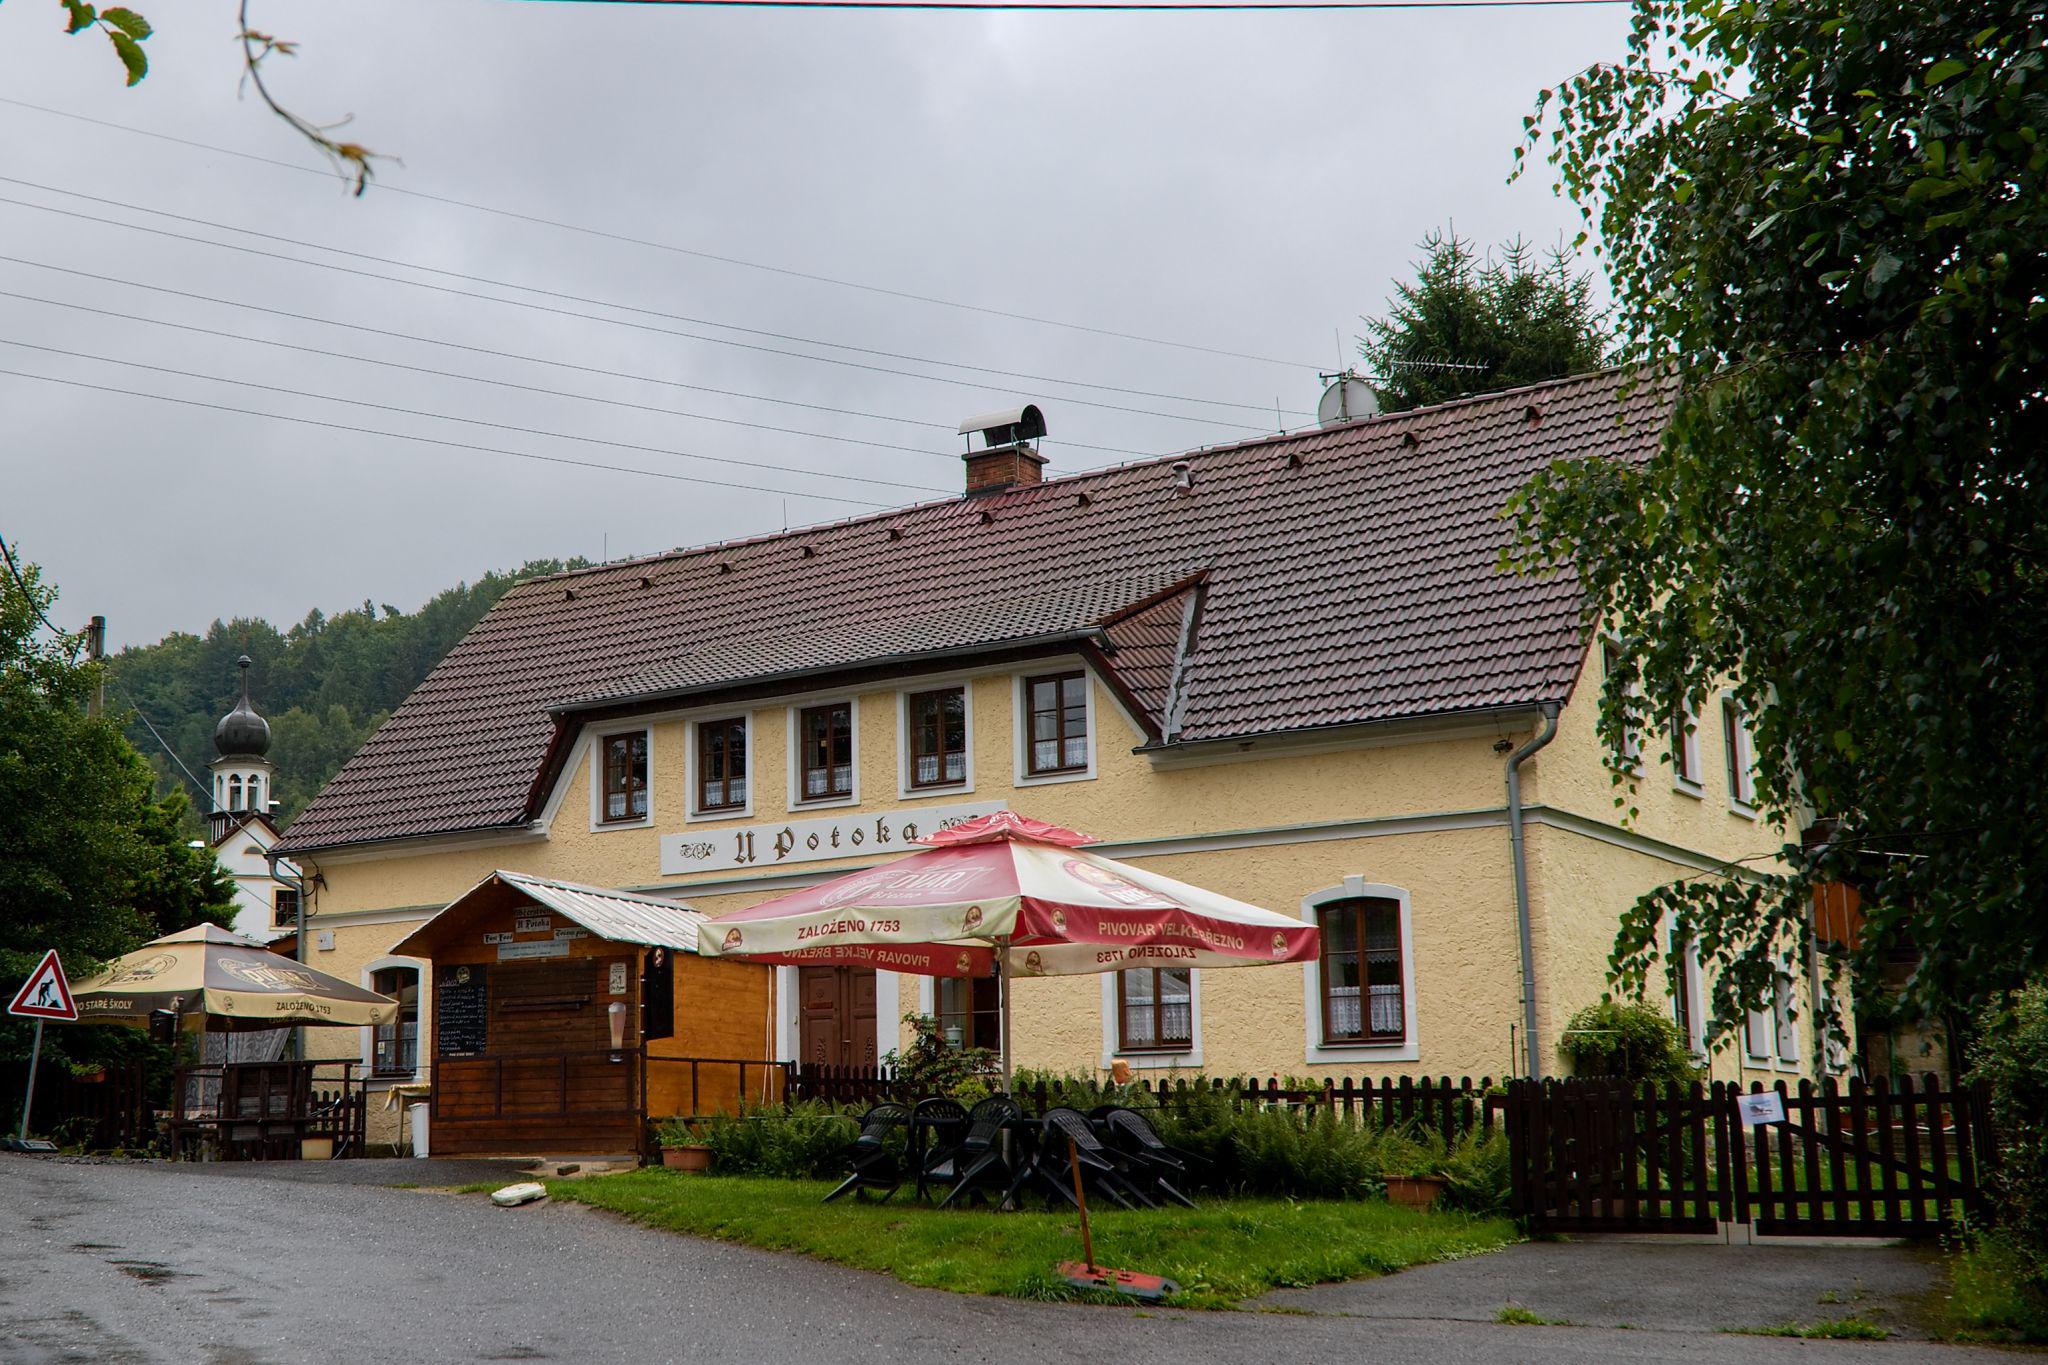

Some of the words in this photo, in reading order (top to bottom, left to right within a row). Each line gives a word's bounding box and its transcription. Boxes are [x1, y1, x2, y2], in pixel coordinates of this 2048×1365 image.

[734, 830, 757, 864] U
[773, 816, 919, 861] Potoka
[798, 918, 865, 940] ZALOŽENO
[869, 919, 900, 933] 1753
[1098, 921, 1156, 937] PIVOVAR
[1198, 928, 1244, 950] BŘEZNO
[85, 998, 108, 1010] STARÉ
[109, 998, 133, 1010] ŠKOLY
[276, 1000, 315, 1012] ZALOŽENO
[316, 1004, 331, 1015] 1753
